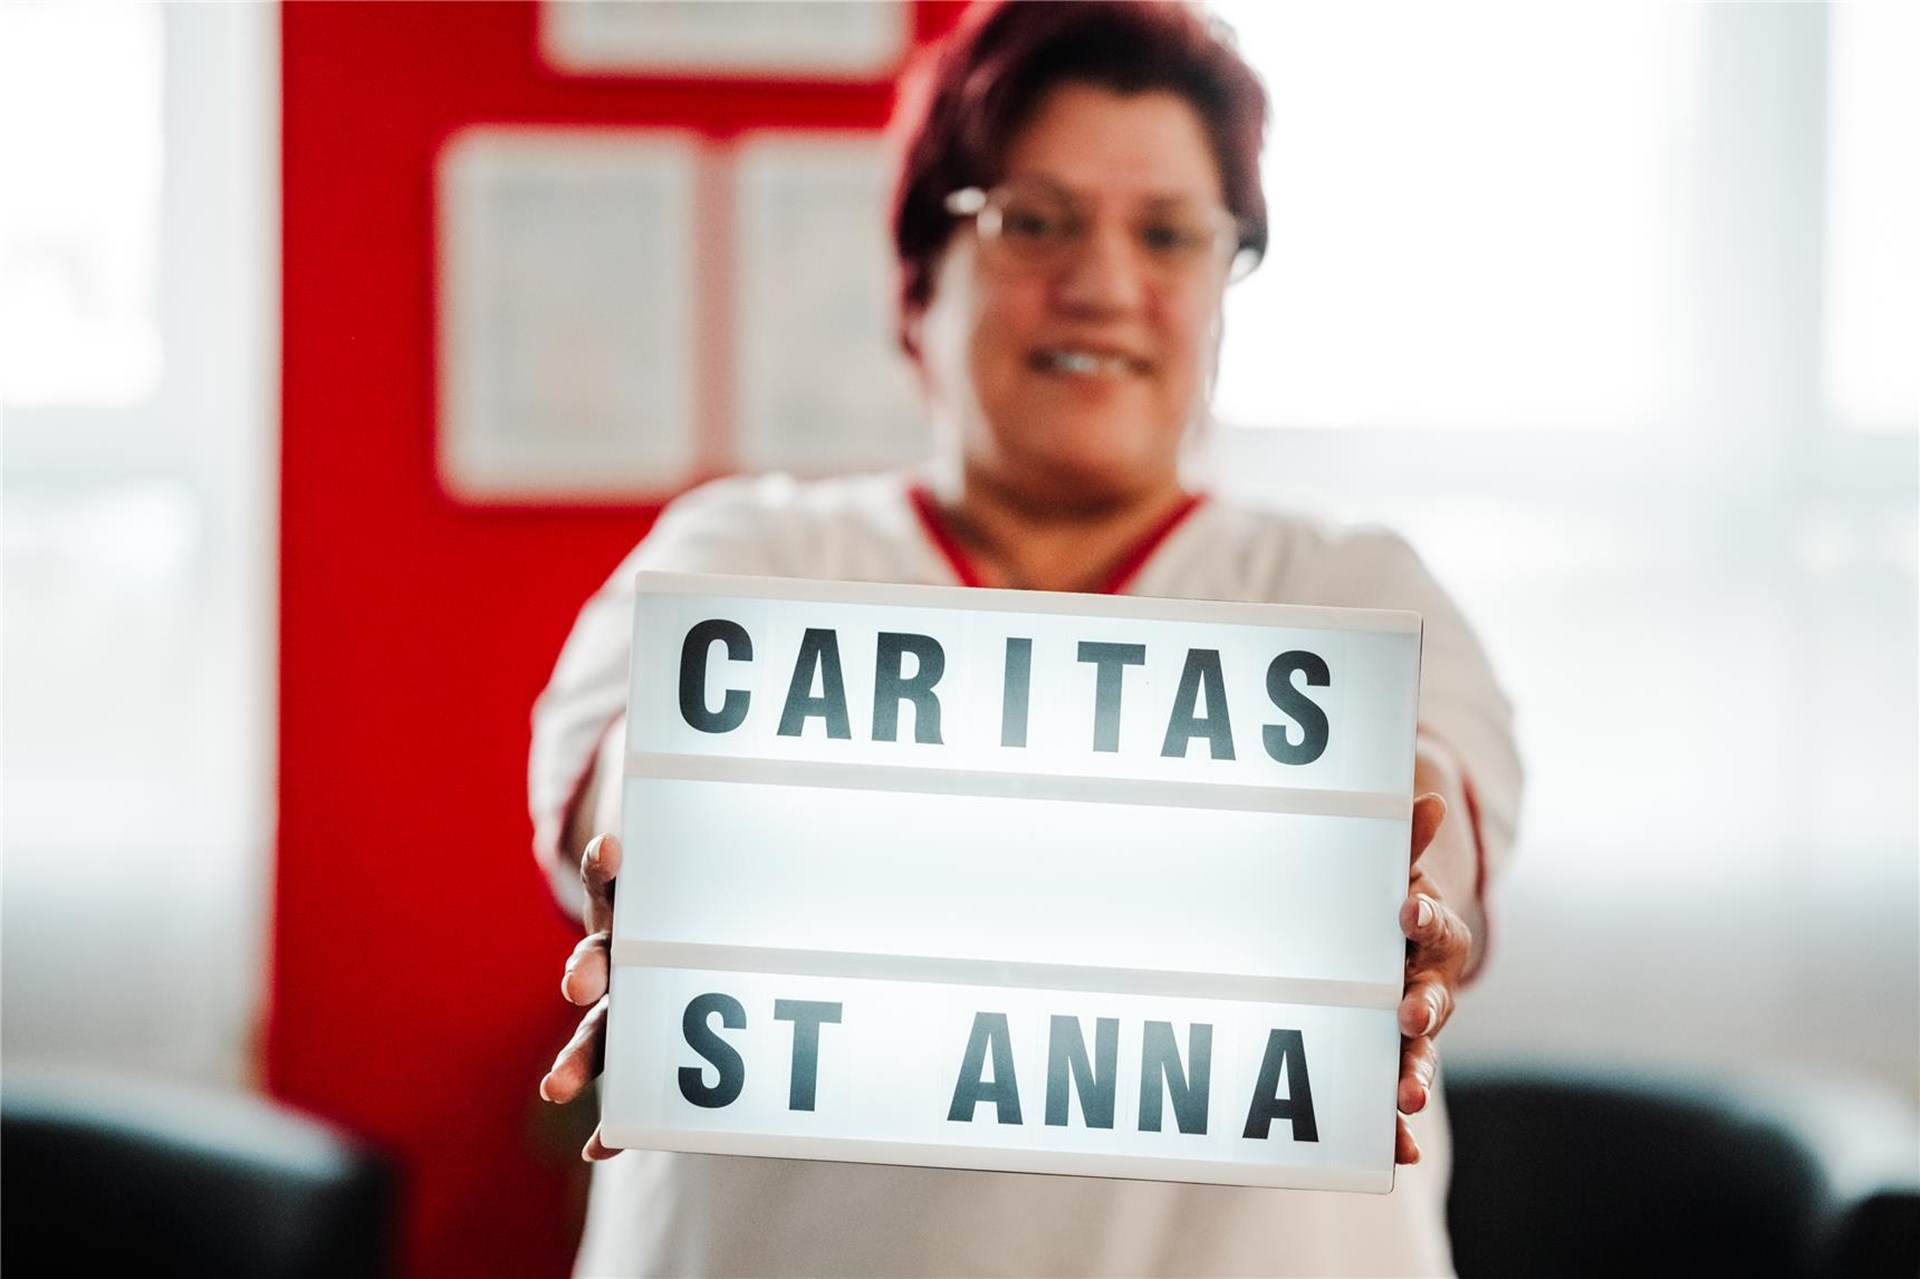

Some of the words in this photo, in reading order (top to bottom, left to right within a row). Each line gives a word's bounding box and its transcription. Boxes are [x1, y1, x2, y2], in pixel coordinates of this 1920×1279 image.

[678, 618, 1331, 766] CARITAS
[677, 993, 843, 1112] ST
[947, 1012, 1320, 1143] ANNA
